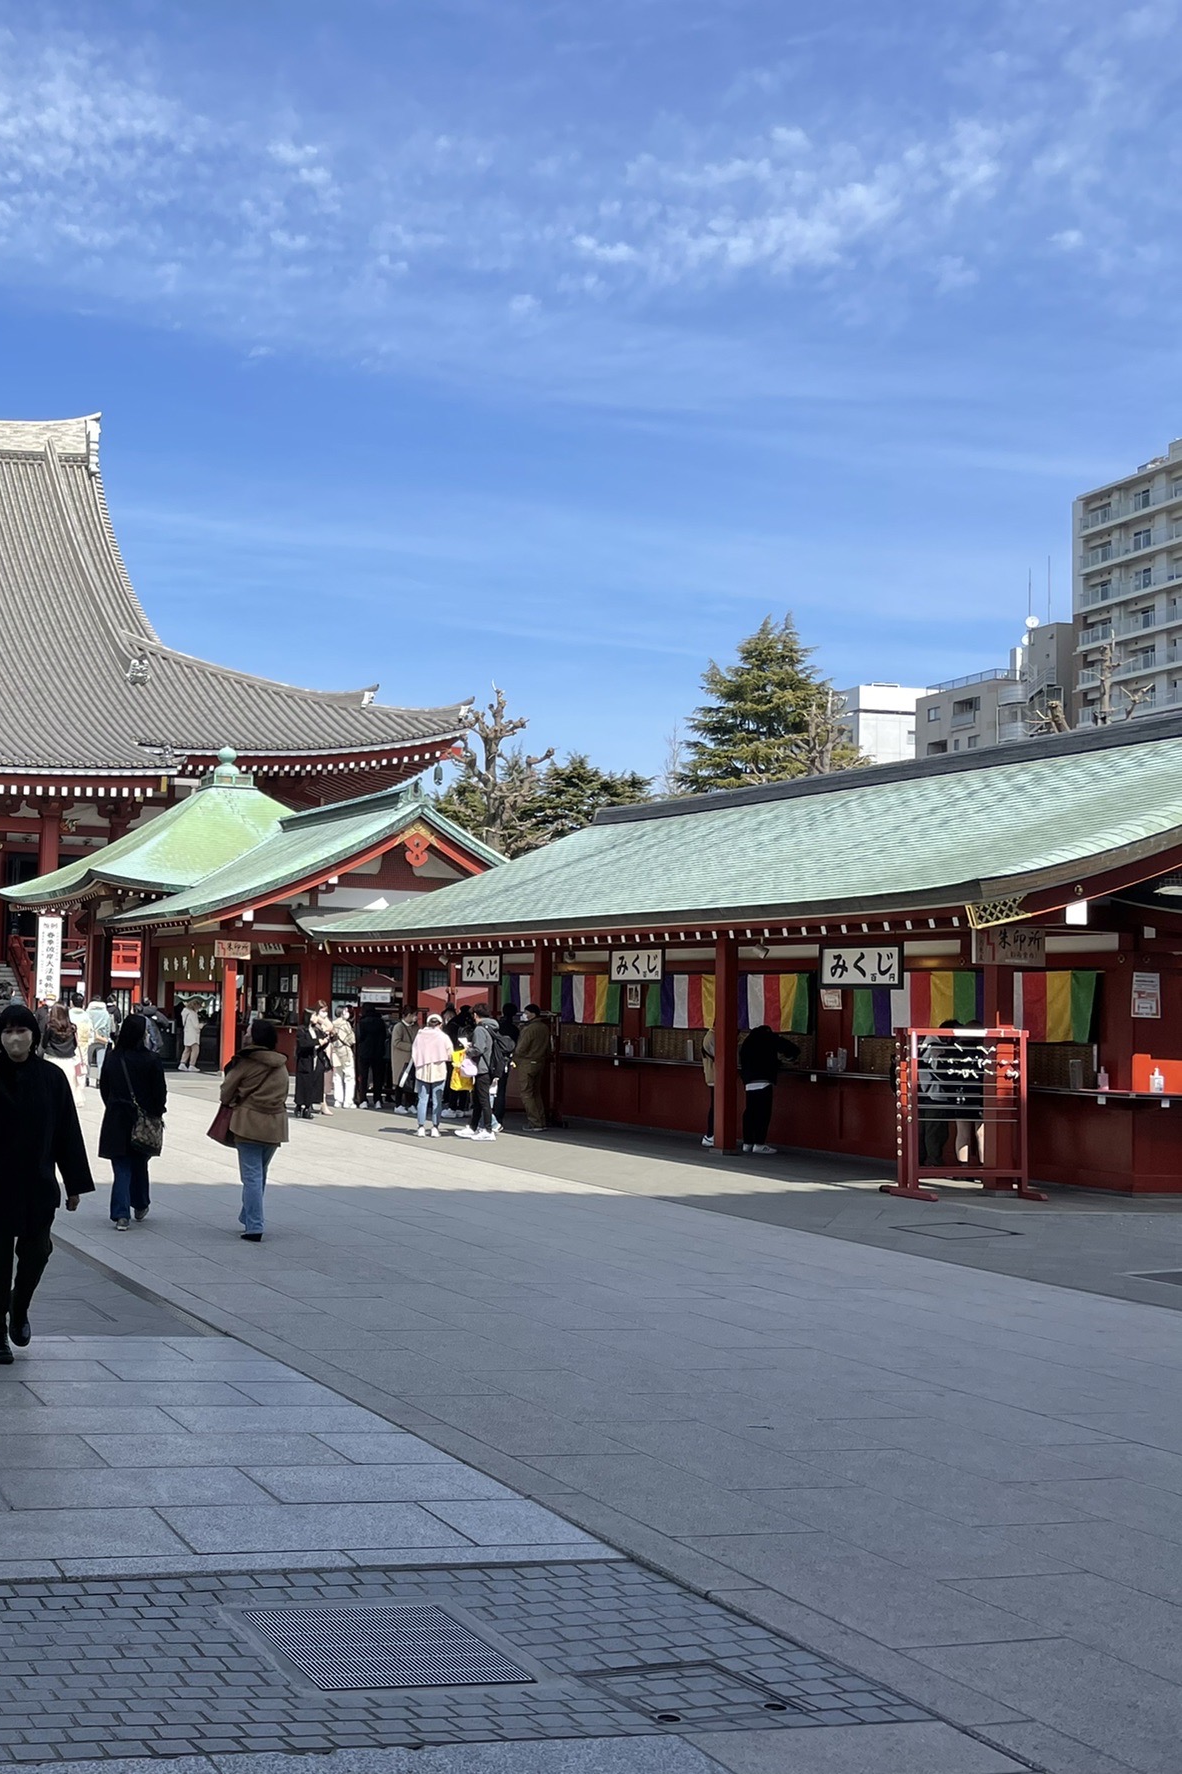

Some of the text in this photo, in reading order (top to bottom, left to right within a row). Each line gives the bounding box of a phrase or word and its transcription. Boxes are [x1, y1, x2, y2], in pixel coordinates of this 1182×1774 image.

[999, 928, 1042, 951] 朱印所
[466, 959, 498, 978] みくじ
[616, 954, 658, 975] みくじ
[830, 952, 894, 978] みくじ
